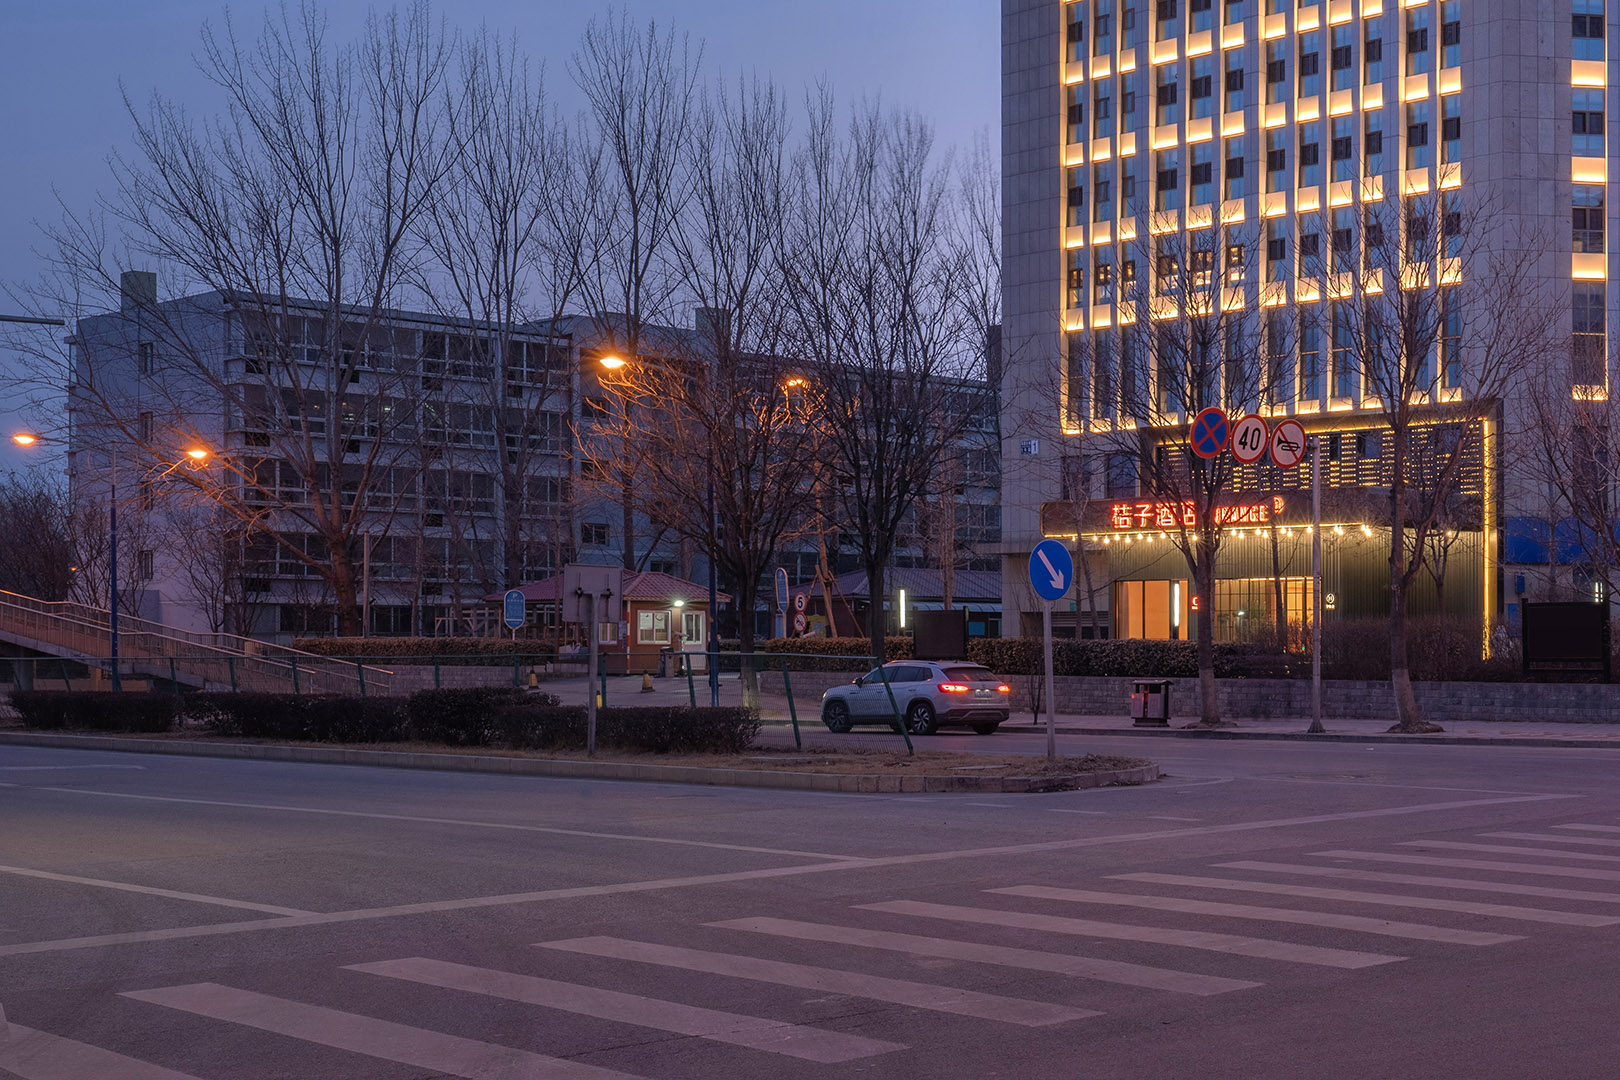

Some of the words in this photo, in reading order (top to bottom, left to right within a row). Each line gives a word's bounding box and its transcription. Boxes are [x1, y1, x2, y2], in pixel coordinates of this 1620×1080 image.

[1239, 426, 1261, 451] 40
[1111, 500, 1197, 530] 桔子酒店
